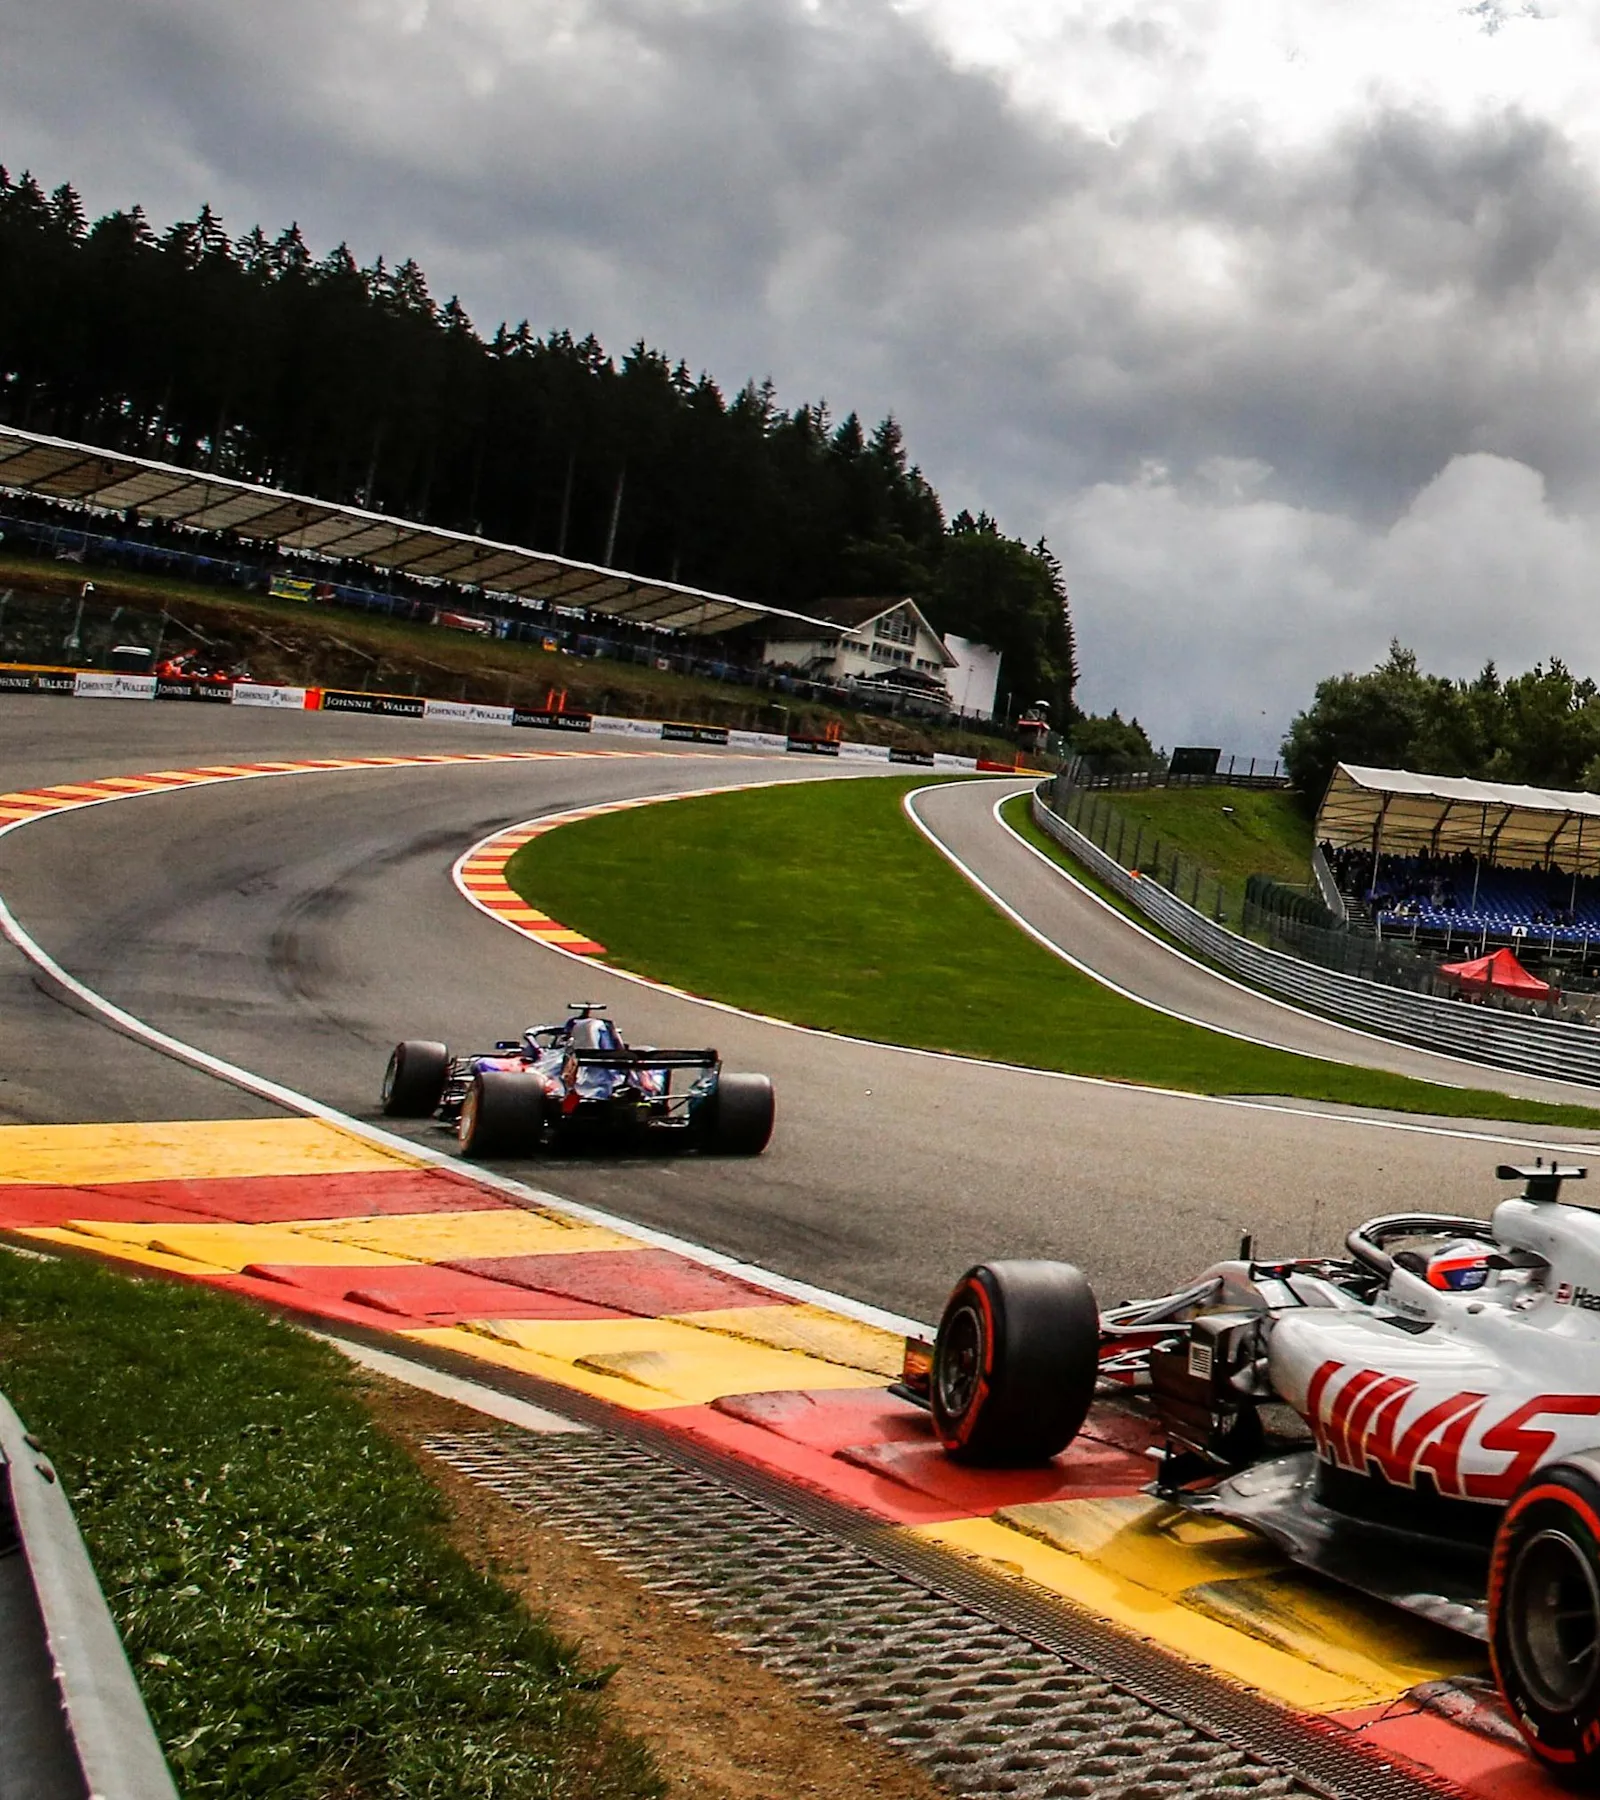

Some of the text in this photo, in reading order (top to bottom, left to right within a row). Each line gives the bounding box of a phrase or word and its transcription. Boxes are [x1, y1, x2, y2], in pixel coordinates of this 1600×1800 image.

[77, 679, 113, 691] JOHNNIE
[326, 696, 424, 714] JOHNNIE WALKER
[426, 705, 512, 721] JOHNNIE WALKER
[558, 717, 590, 728] WALKER
[1515, 926, 1523, 936] A
